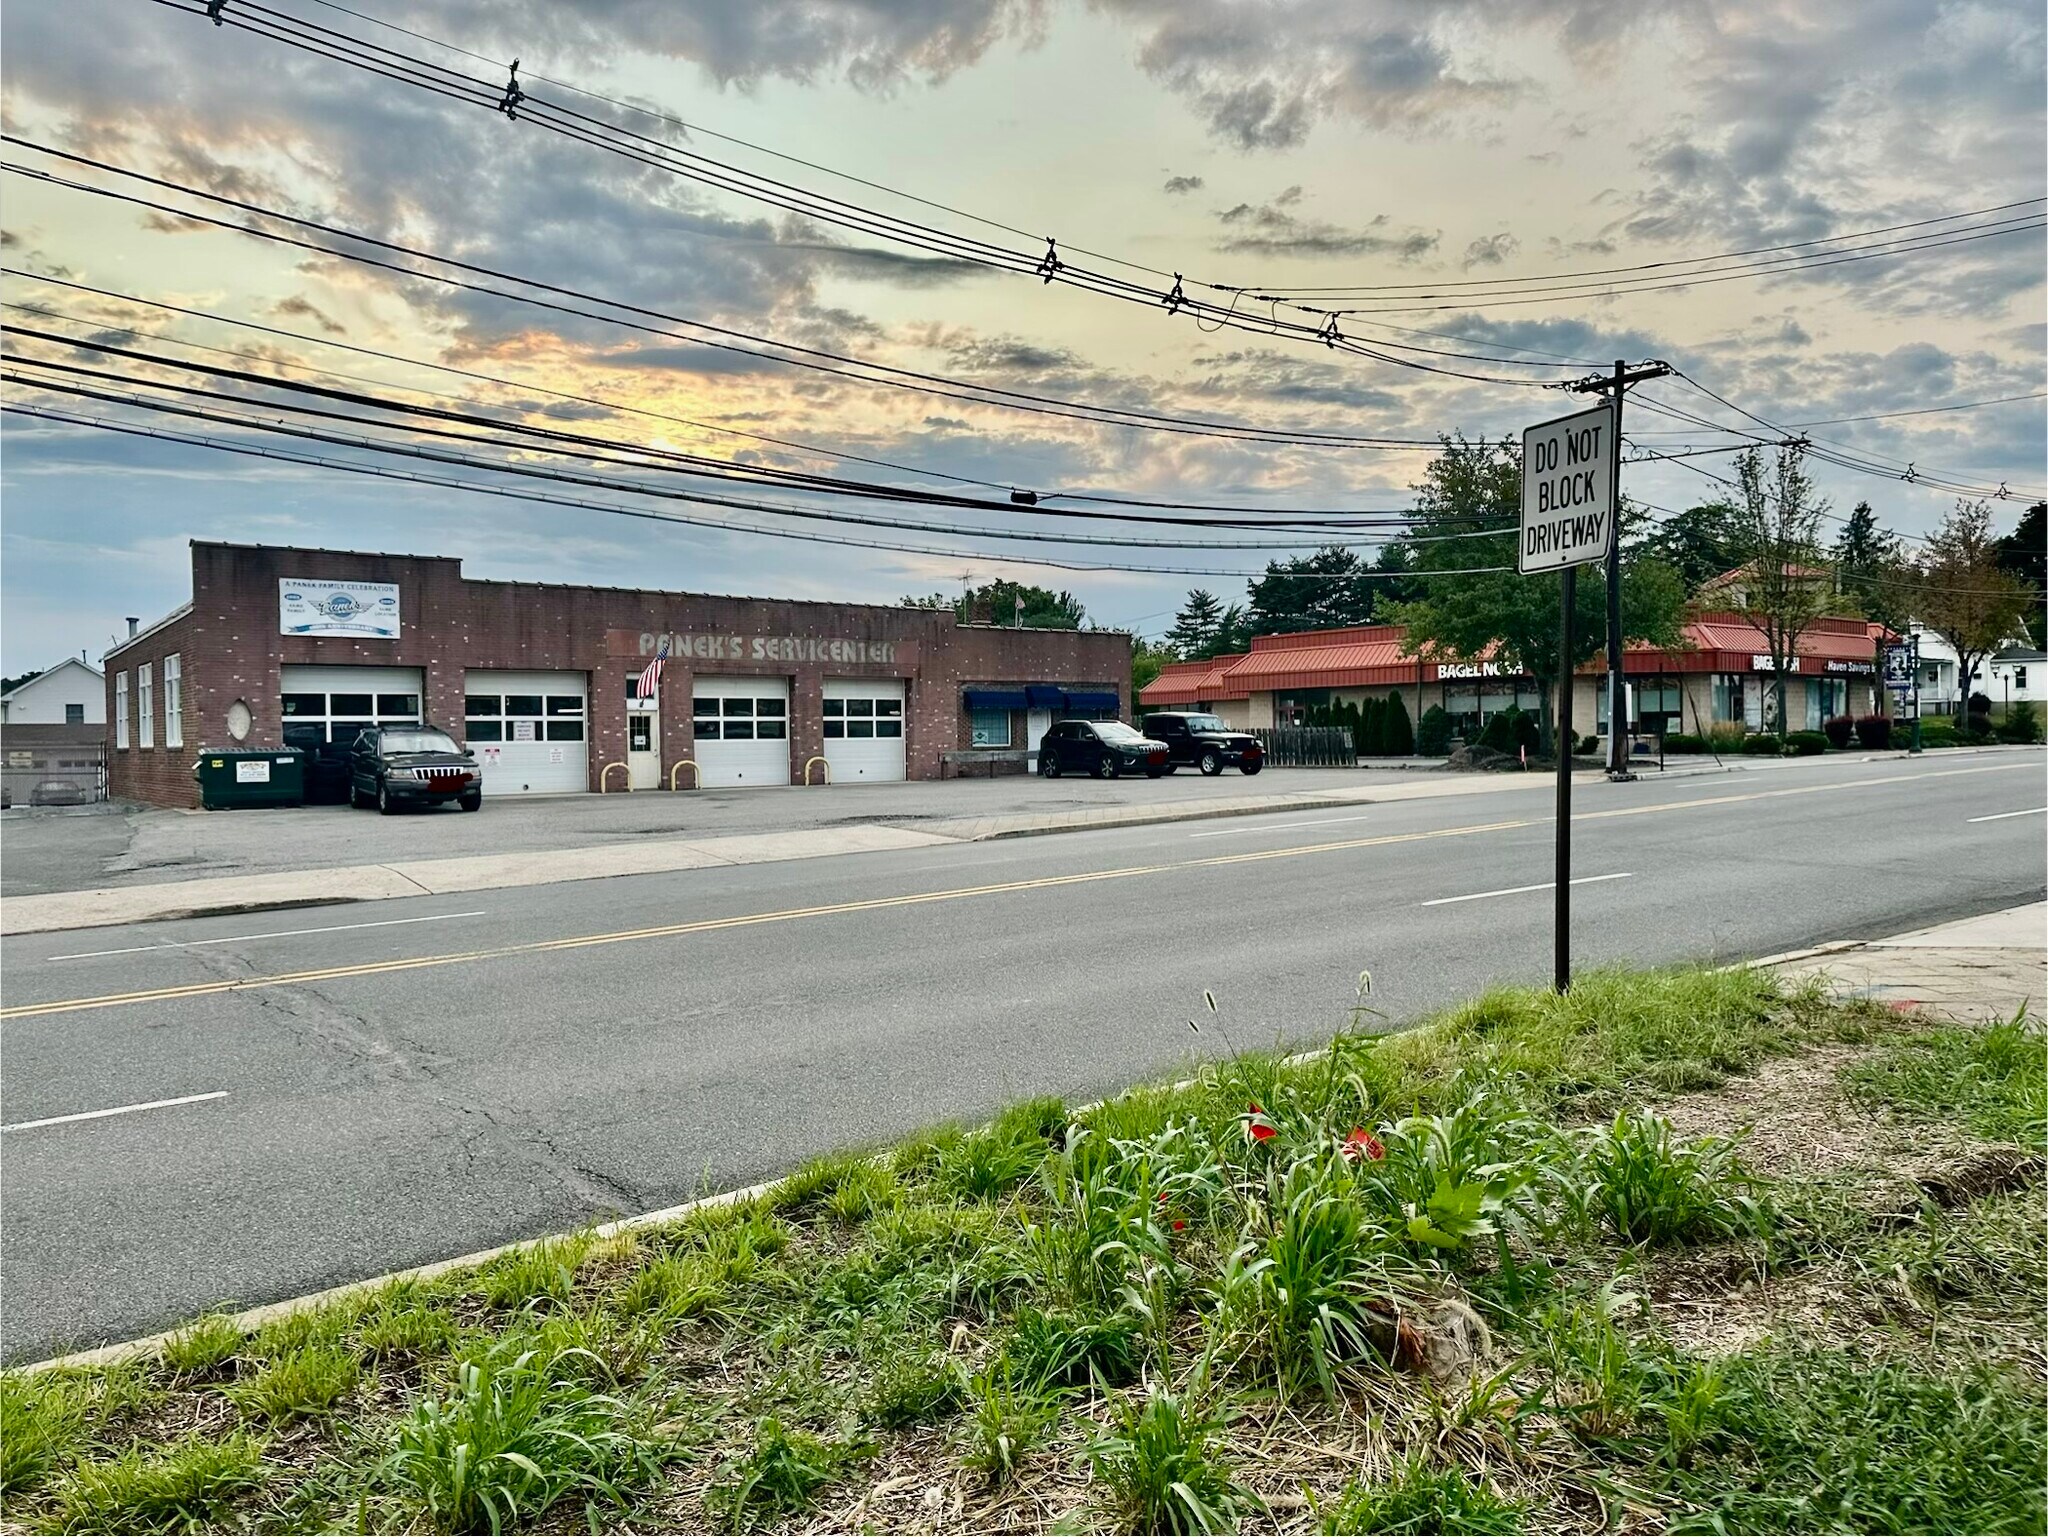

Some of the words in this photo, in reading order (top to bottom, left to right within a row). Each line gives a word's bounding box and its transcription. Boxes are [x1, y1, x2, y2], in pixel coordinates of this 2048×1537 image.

[1535, 437, 1559, 474] DO
[1567, 426, 1602, 467] NOT
[1538, 470, 1596, 514] BLOCK
[1526, 511, 1606, 556] DRIVEWAY
[346, 584, 395, 592] CELEBRATION
[639, 632, 744, 659] PANEK'S
[751, 637, 895, 663] SERVICENTER
[1437, 663, 1482, 679] BAGEL
[1753, 655, 1776, 671] BAGE
[1827, 660, 1847, 672] Haven
[1848, 661, 1870, 675] Savings
